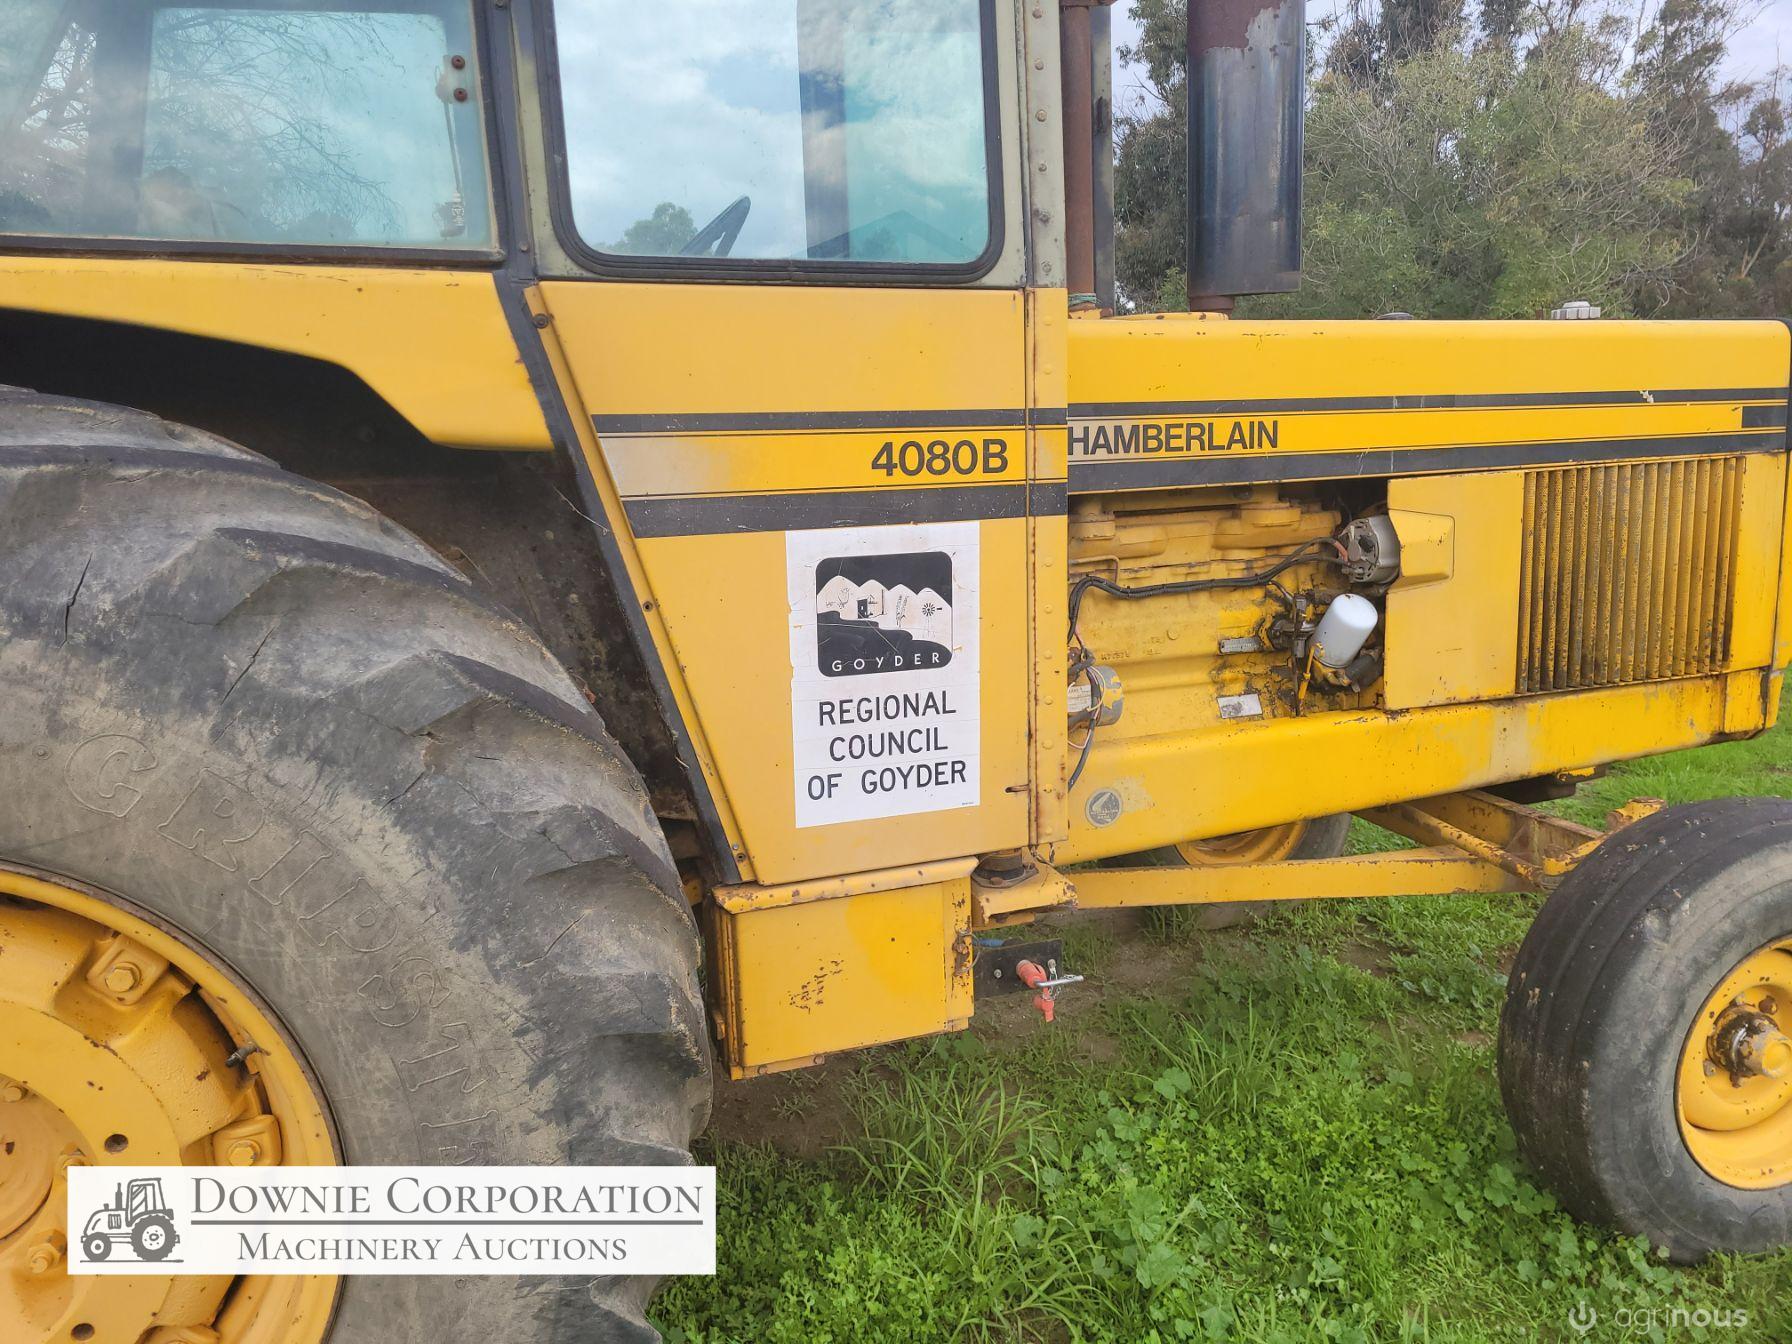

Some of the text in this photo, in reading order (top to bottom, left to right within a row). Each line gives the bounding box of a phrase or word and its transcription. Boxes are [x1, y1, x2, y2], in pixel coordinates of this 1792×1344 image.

[1068, 420, 1279, 456] HAMBERLAIN
[871, 438, 1009, 477] 4080B
[831, 652, 941, 673] GOYDER
[818, 690, 957, 727] REGIONAL
[829, 727, 949, 762] COUNCIL
[807, 760, 967, 801] OF GOYDER
